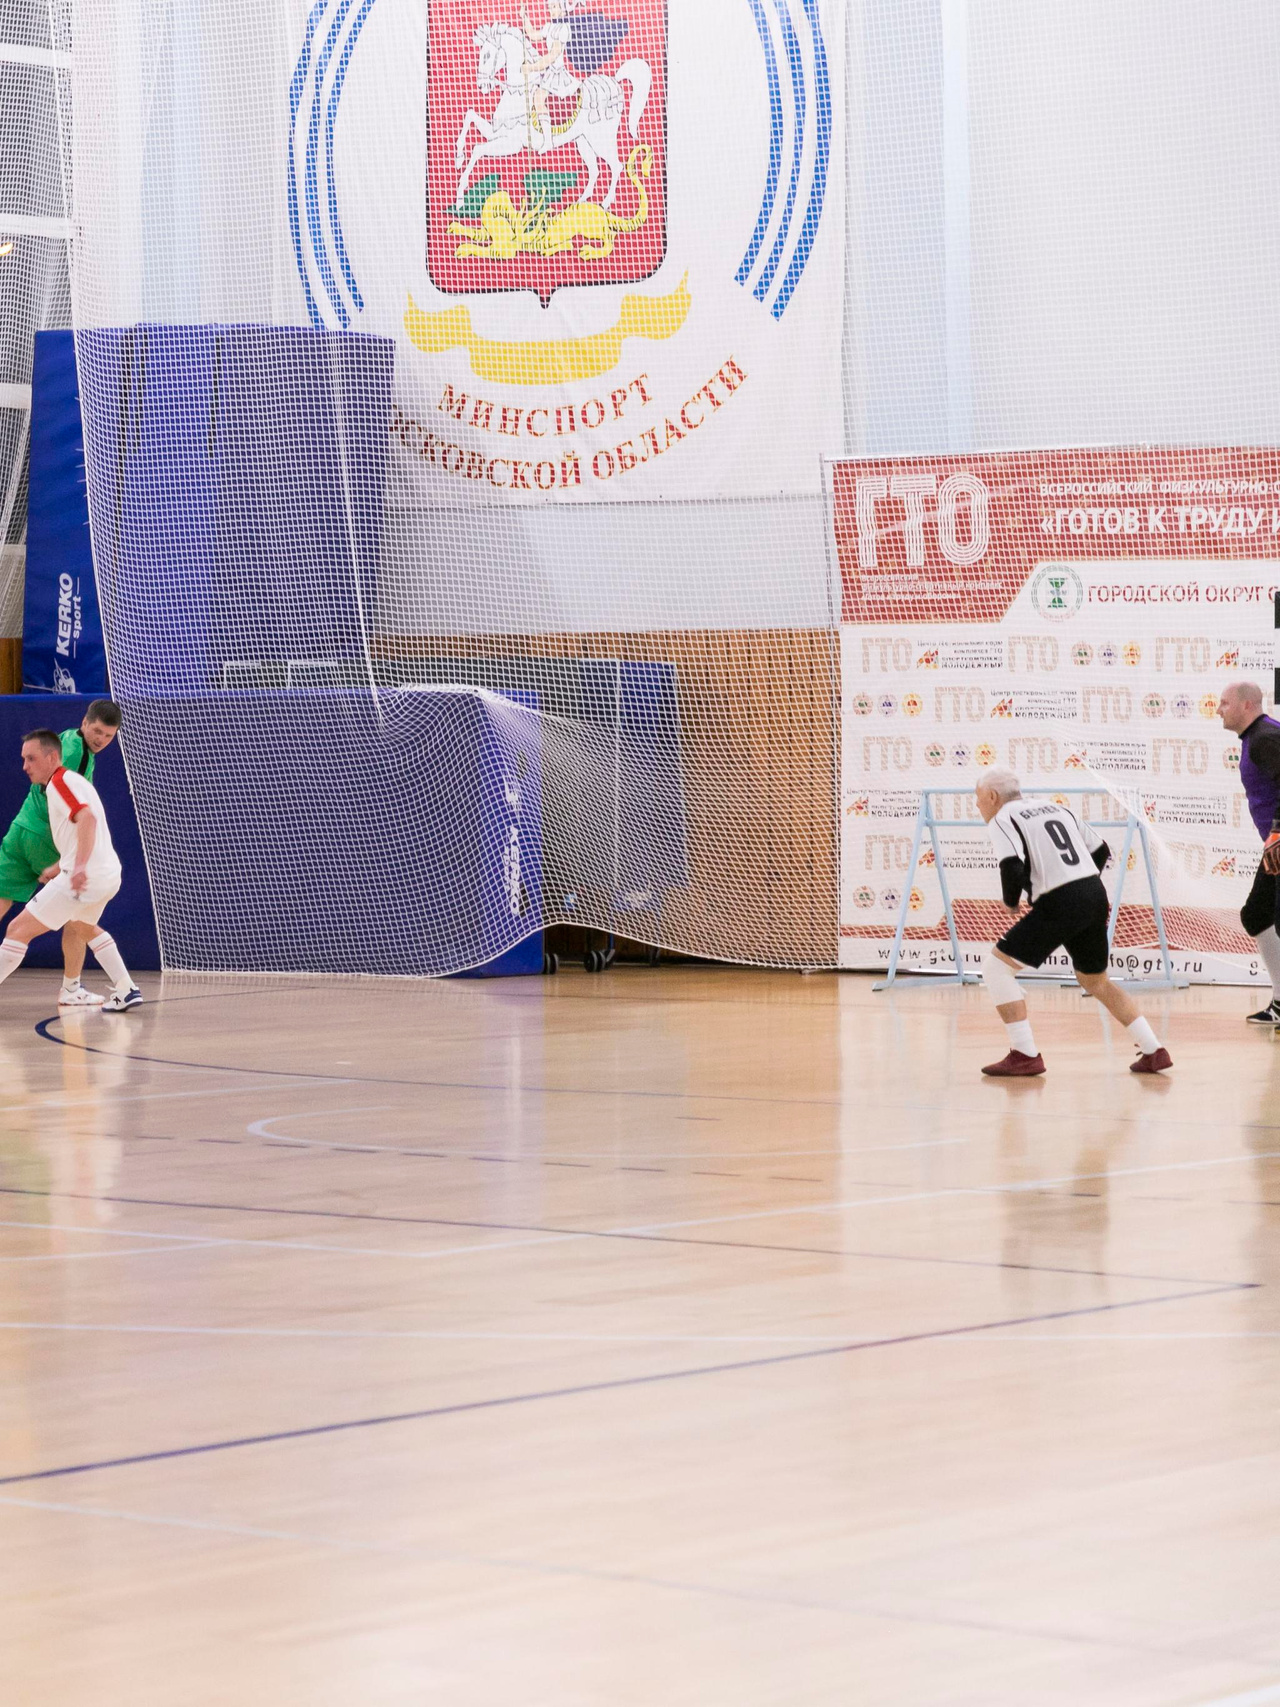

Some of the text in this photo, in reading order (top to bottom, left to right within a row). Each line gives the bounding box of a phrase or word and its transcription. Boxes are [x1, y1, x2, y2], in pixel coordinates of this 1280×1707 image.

[388, 354, 749, 490] СКОВСКОЙ ОБЛАСТИ
[438, 372, 653, 438] МИНСПОРТ
[855, 472, 990, 567] ГТО
[1149, 508, 1167, 534] К
[1173, 507, 1265, 538] ТРУДУ
[1088, 582, 1199, 604] ГОРОДСКОЙ
[1205, 585, 1263, 602] ОКРУГ
[56, 572, 73, 657] KERKO
[72, 595, 82, 639] sport
[862, 637, 913, 673] ГТО
[1008, 636, 1059, 672] ГТО
[1155, 636, 1211, 673] ГТО
[935, 686, 985, 722] ГТО
[1082, 686, 1132, 723] ГТО
[863, 736, 913, 772] ГТО
[1008, 736, 1059, 773] ГТО
[1151, 738, 1209, 775] ГТО
[864, 834, 914, 871] ГТО
[1044, 820, 1080, 867] 9
[510, 825, 520, 916] KERKO
